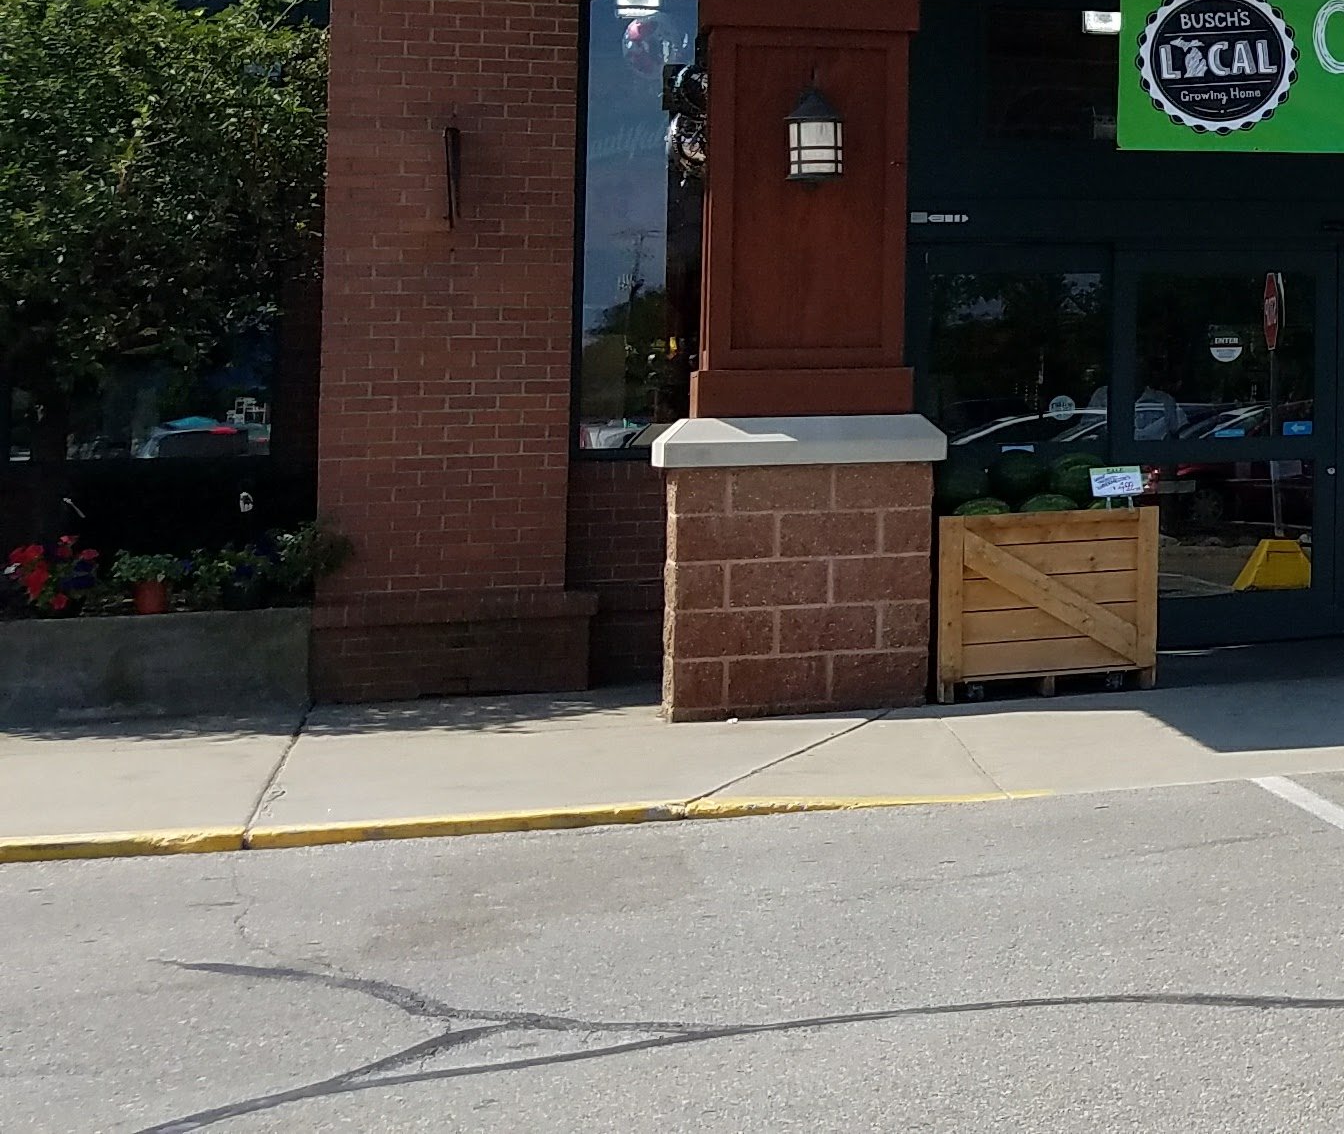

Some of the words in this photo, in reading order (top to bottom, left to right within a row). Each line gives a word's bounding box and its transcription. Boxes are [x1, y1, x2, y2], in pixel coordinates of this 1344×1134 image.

[1180, 8, 1251, 30] BUSCH'S
[1180, 90, 1229, 105] Growing
[1230, 87, 1262, 100] Home
